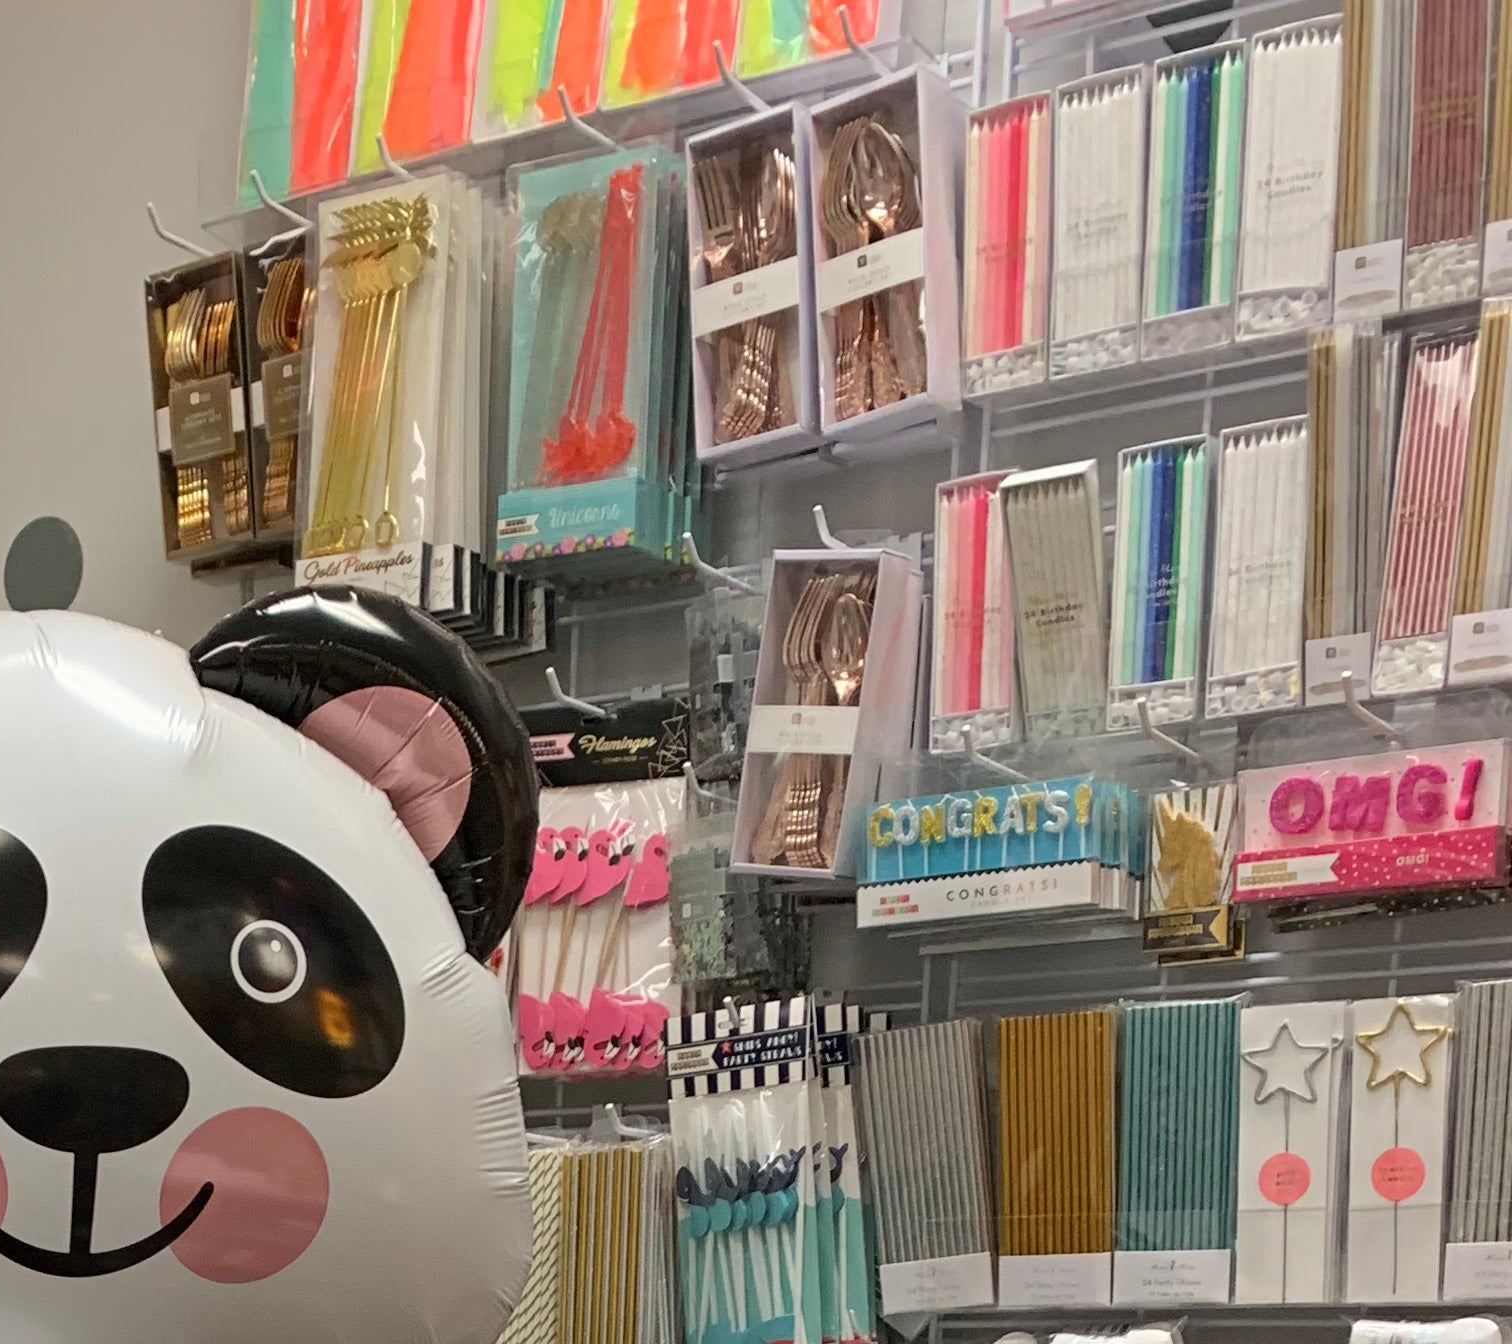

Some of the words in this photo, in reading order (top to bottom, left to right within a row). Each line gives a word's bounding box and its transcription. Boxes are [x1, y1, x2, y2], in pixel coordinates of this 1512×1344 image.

[548, 504, 619, 530] Unicorns
[304, 556, 342, 590] Gold
[343, 552, 414, 584] Pineapples
[870, 782, 1093, 848] CONGRATS!
[1269, 758, 1485, 836] OMG!
[946, 877, 1060, 903] CONGRATS!
